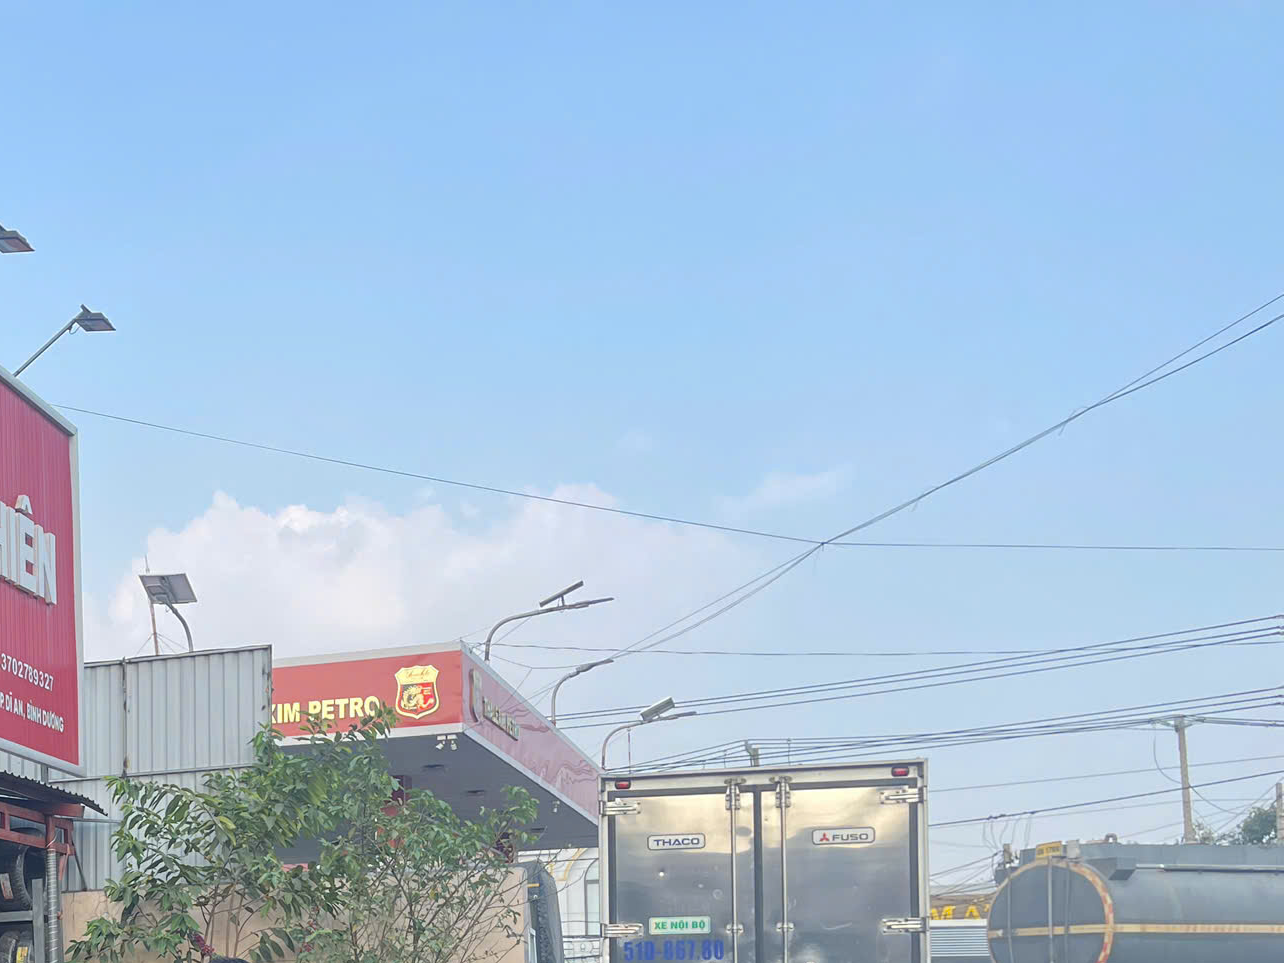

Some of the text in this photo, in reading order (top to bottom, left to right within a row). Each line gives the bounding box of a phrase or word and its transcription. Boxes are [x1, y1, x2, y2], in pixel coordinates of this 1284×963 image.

[308, 696, 381, 721] PETRO
[653, 837, 700, 847] THACO
[831, 833, 869, 842] FUSO
[654, 921, 667, 930] XE
[692, 919, 706, 931] BỘ
[623, 940, 724, 962] 51D-867.80
